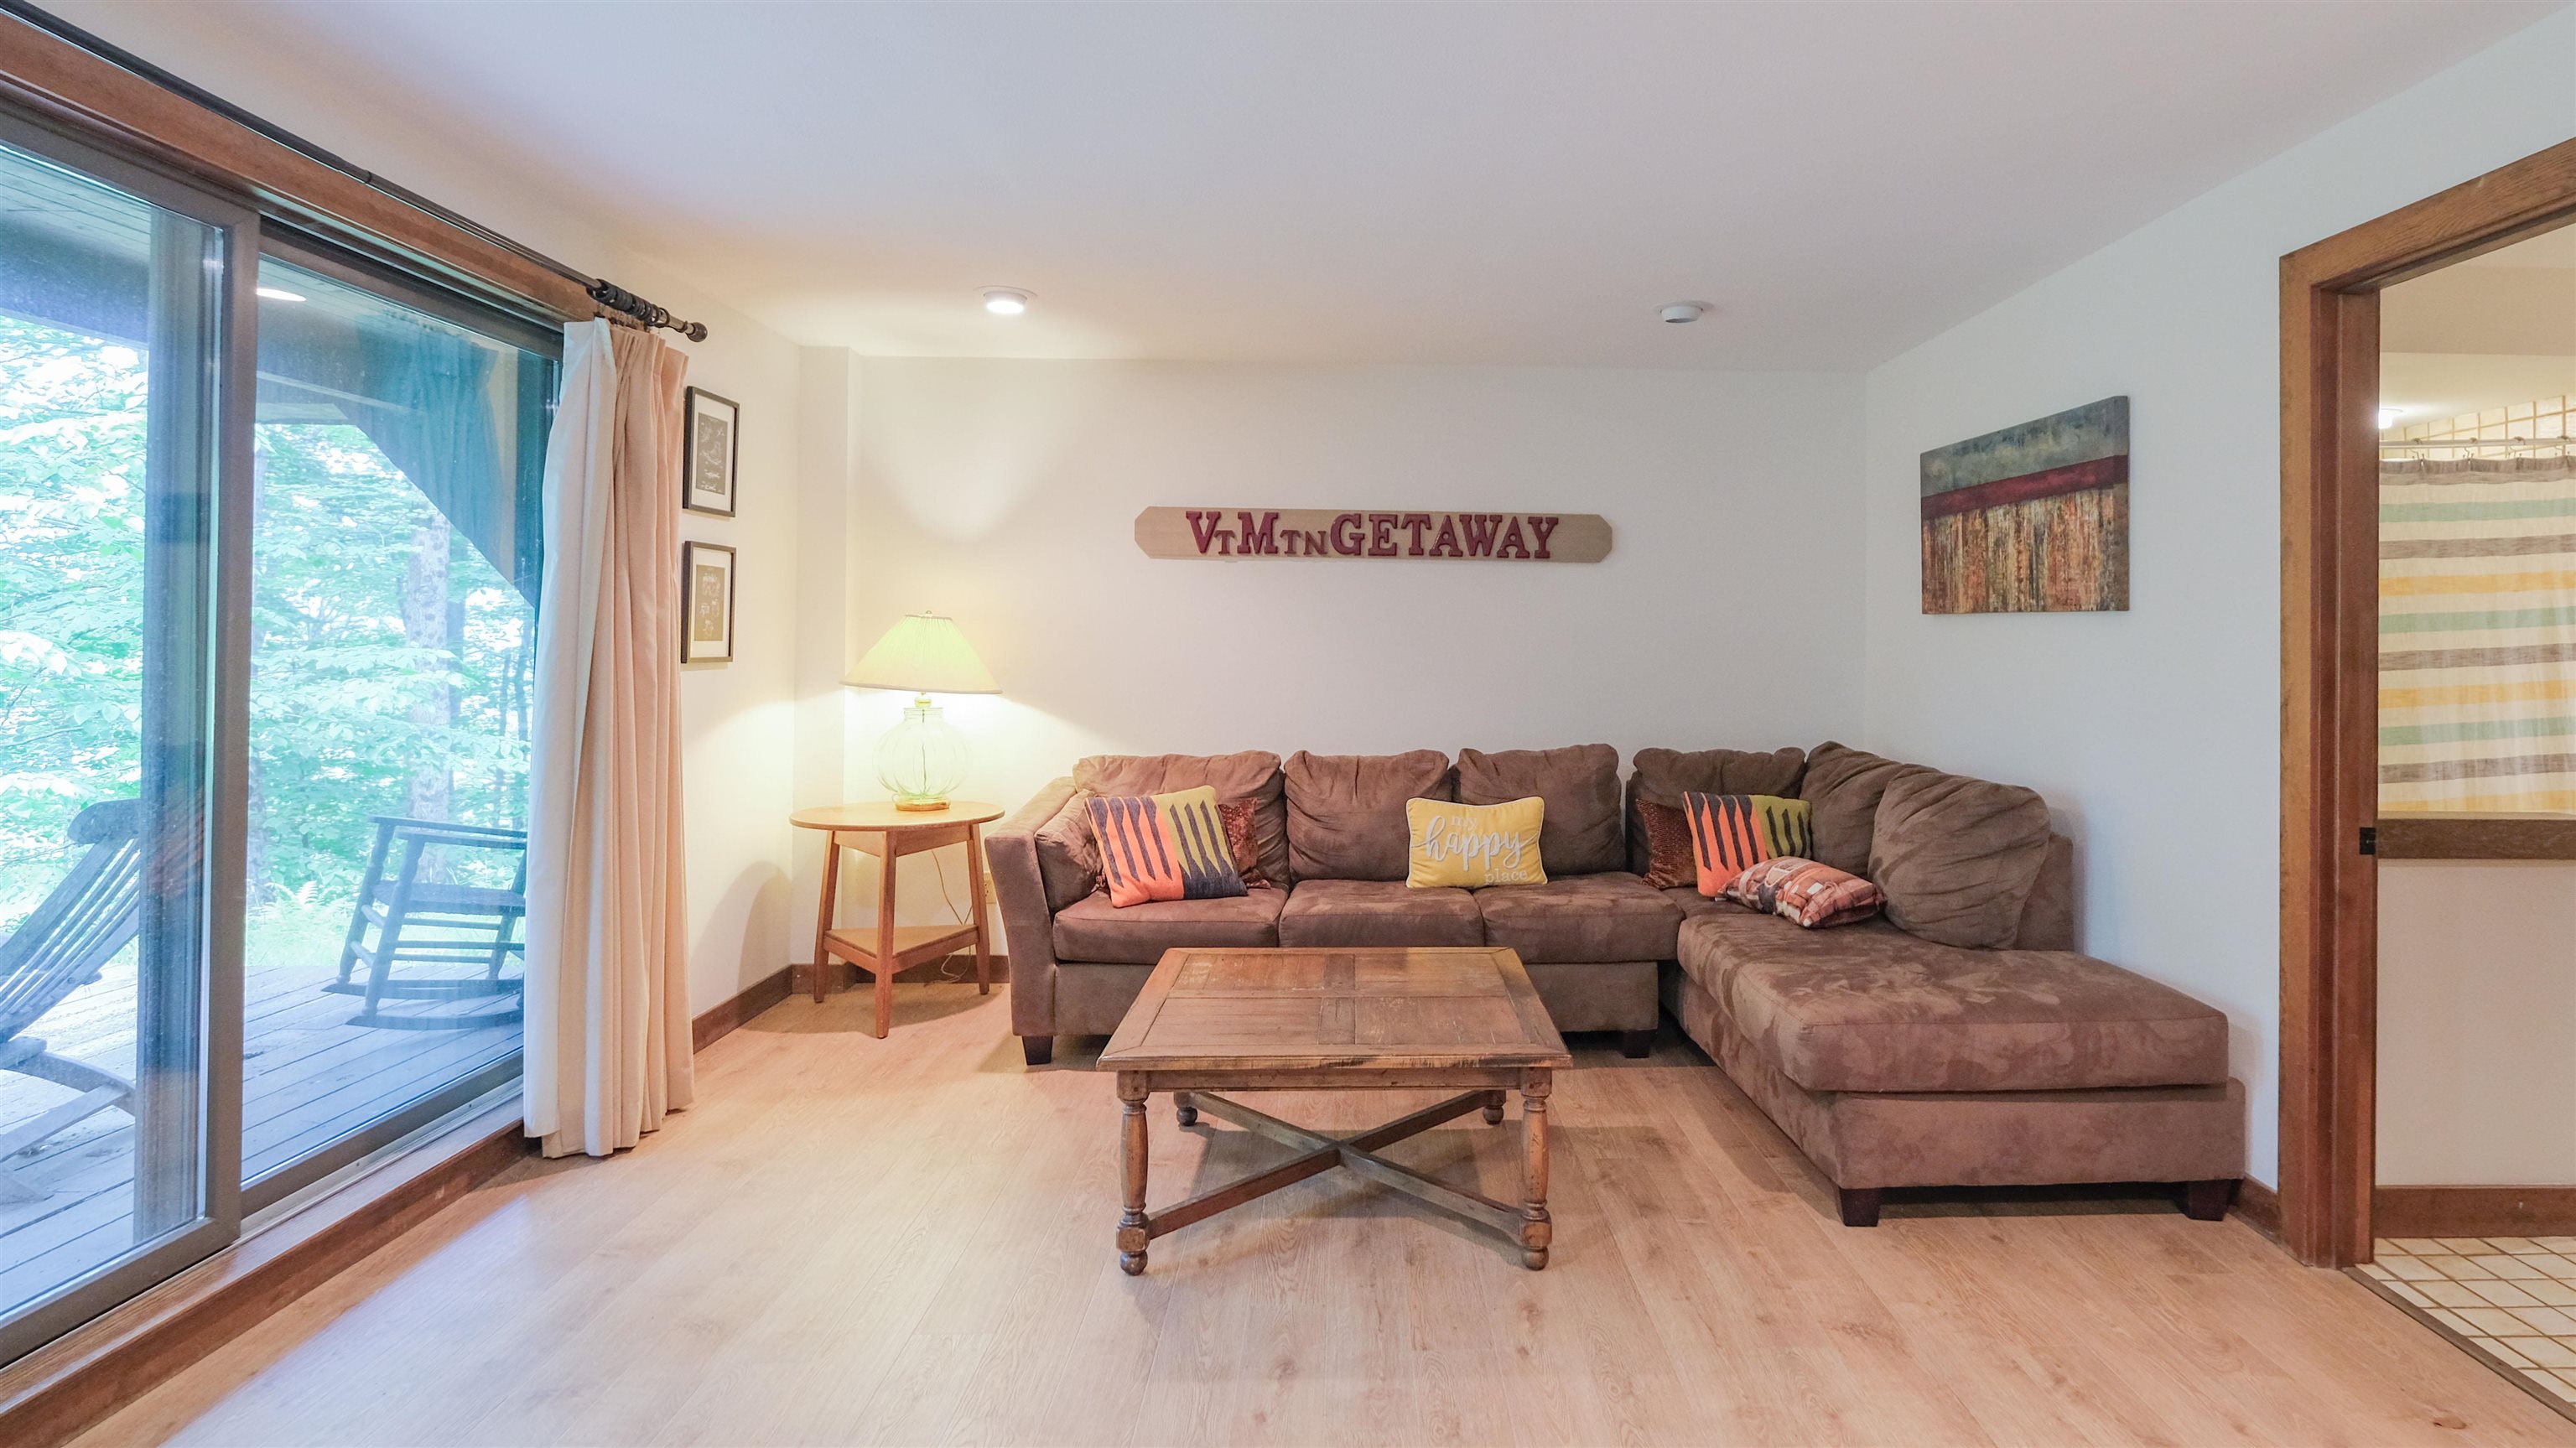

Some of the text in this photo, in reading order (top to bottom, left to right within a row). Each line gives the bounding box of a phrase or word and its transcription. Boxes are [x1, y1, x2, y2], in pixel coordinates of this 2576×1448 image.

[1330, 513, 1559, 559] GETAWAY
[1451, 816, 1478, 831] my
[1417, 816, 1531, 871] happy
[1483, 869, 1529, 885] place
